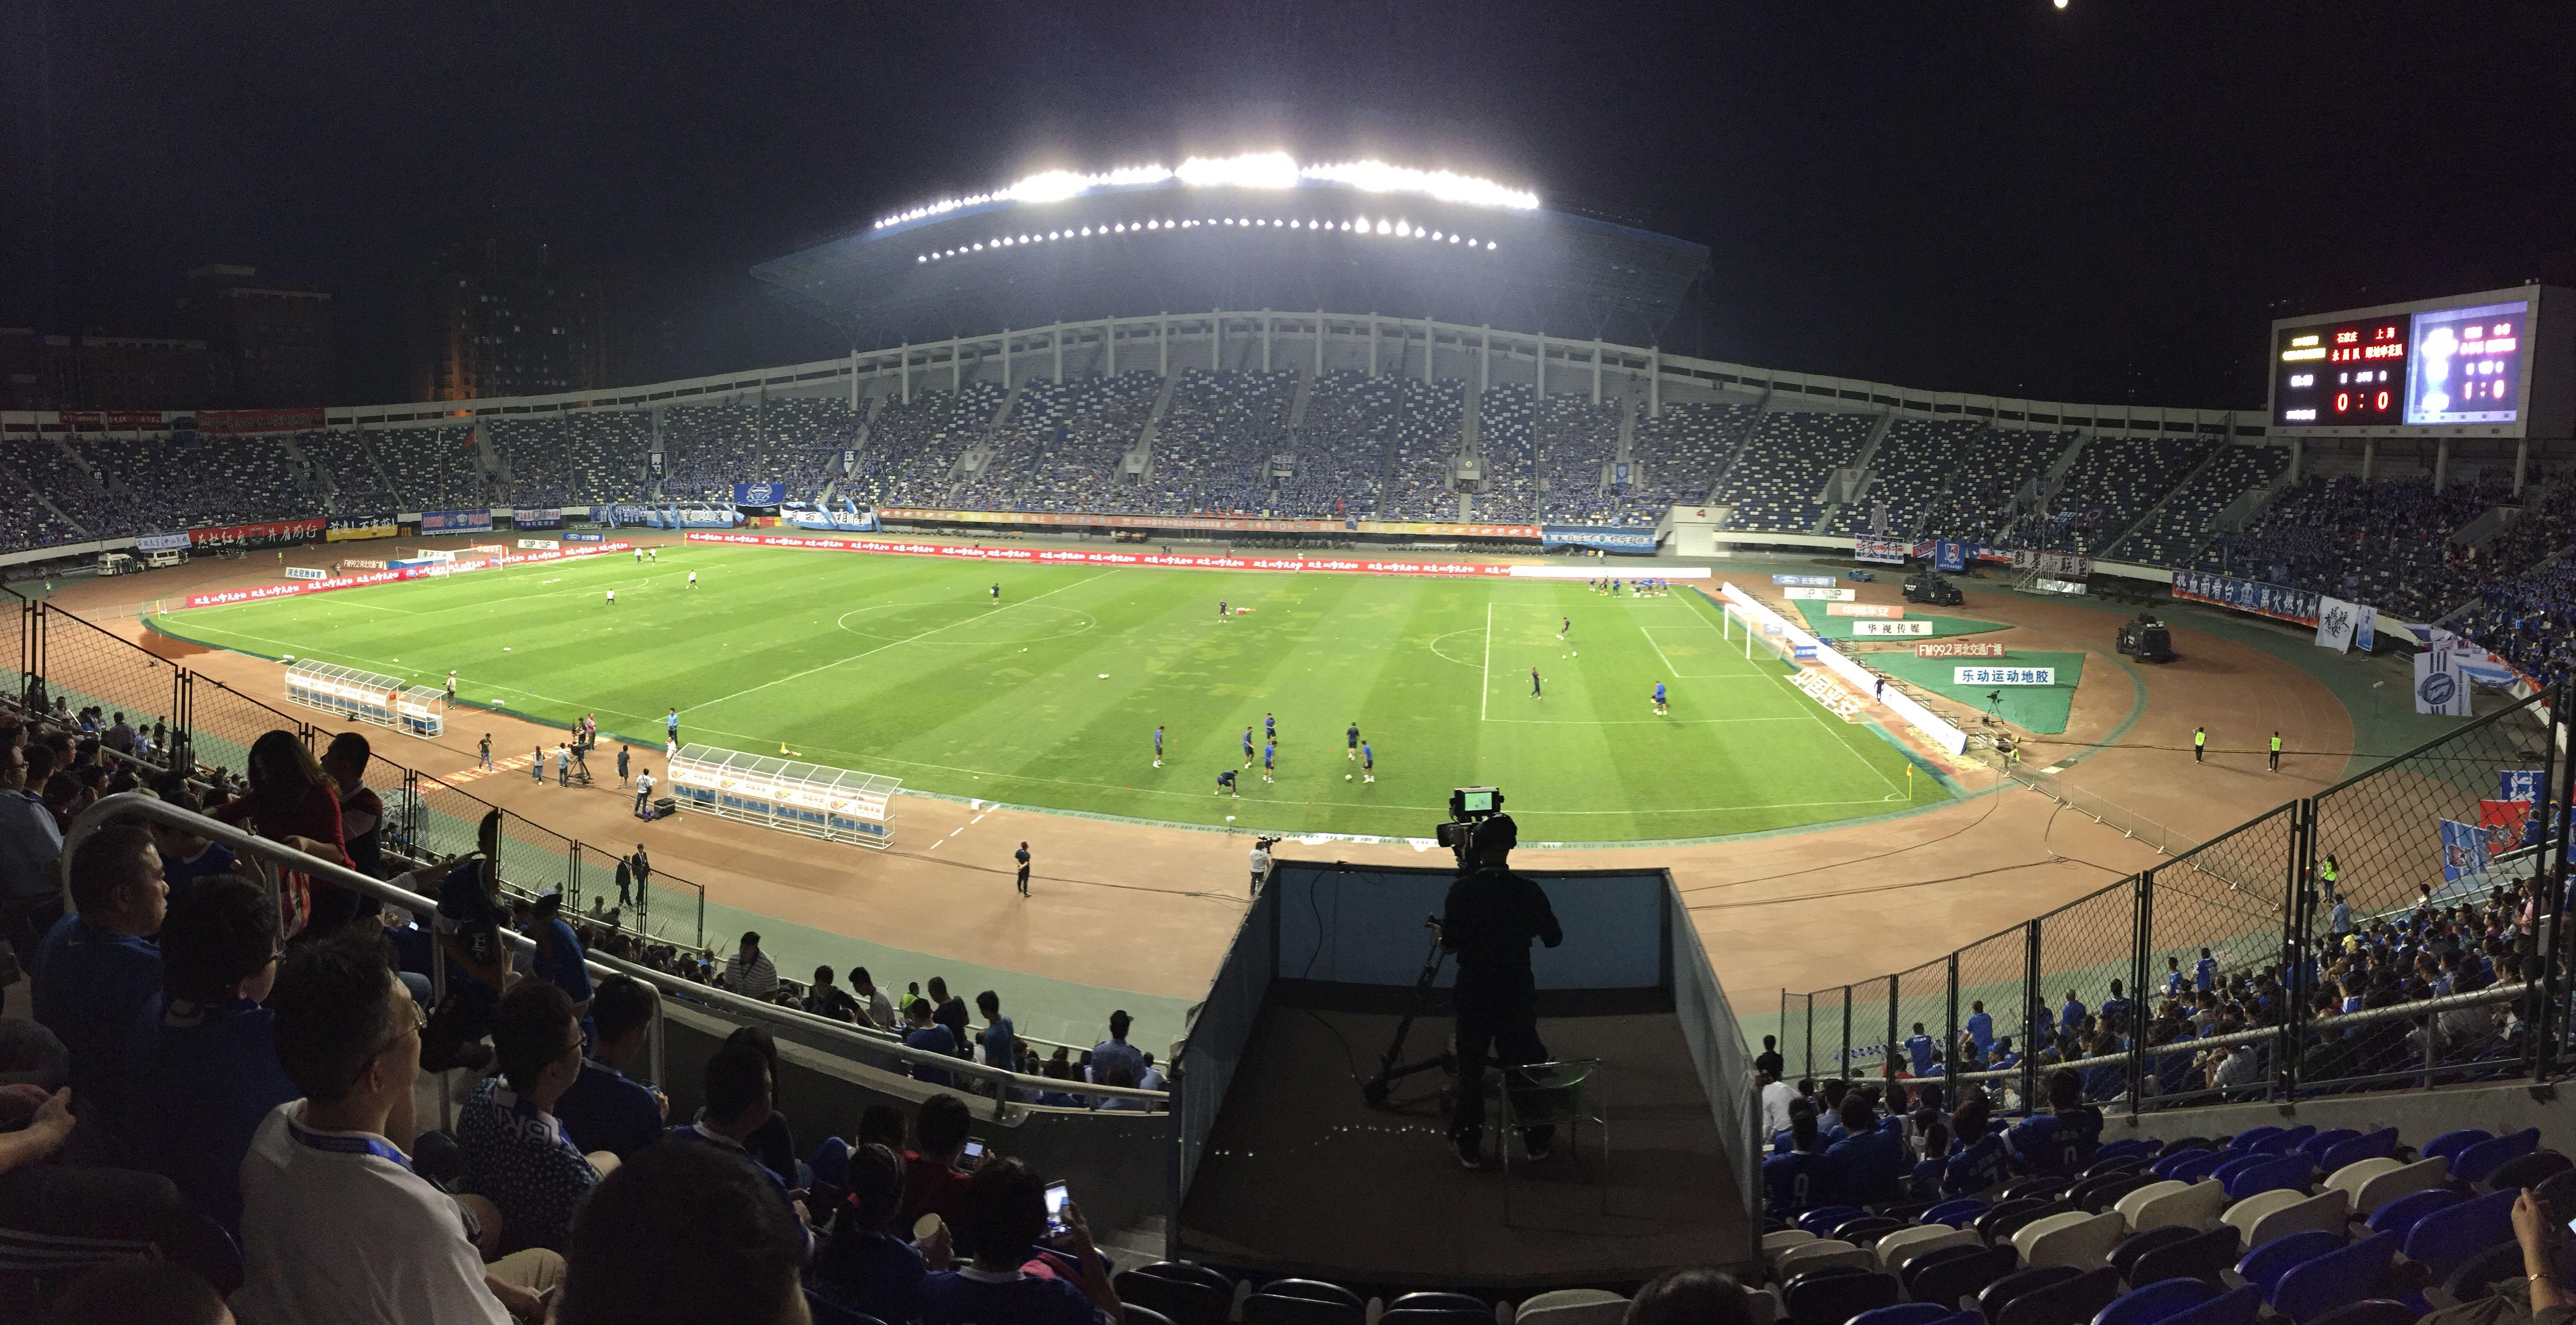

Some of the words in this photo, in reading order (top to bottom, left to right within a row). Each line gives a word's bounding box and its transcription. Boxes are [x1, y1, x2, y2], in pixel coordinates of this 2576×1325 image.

[2337, 331, 2358, 344] 石家庄
[2375, 327, 2395, 339] 上海
[1696, 509, 1706, 518] 4
[288, 568, 322, 579] 河北冠胜体育
[2176, 571, 2234, 602] 热血南看台
[1843, 605, 1889, 617] 中国平安
[1868, 623, 1921, 634] 华视传媒
[1963, 669, 2049, 683] 乐动运动地胶
[1794, 667, 1863, 721] 中国平安
[857, 804, 881, 813] 中国平安
